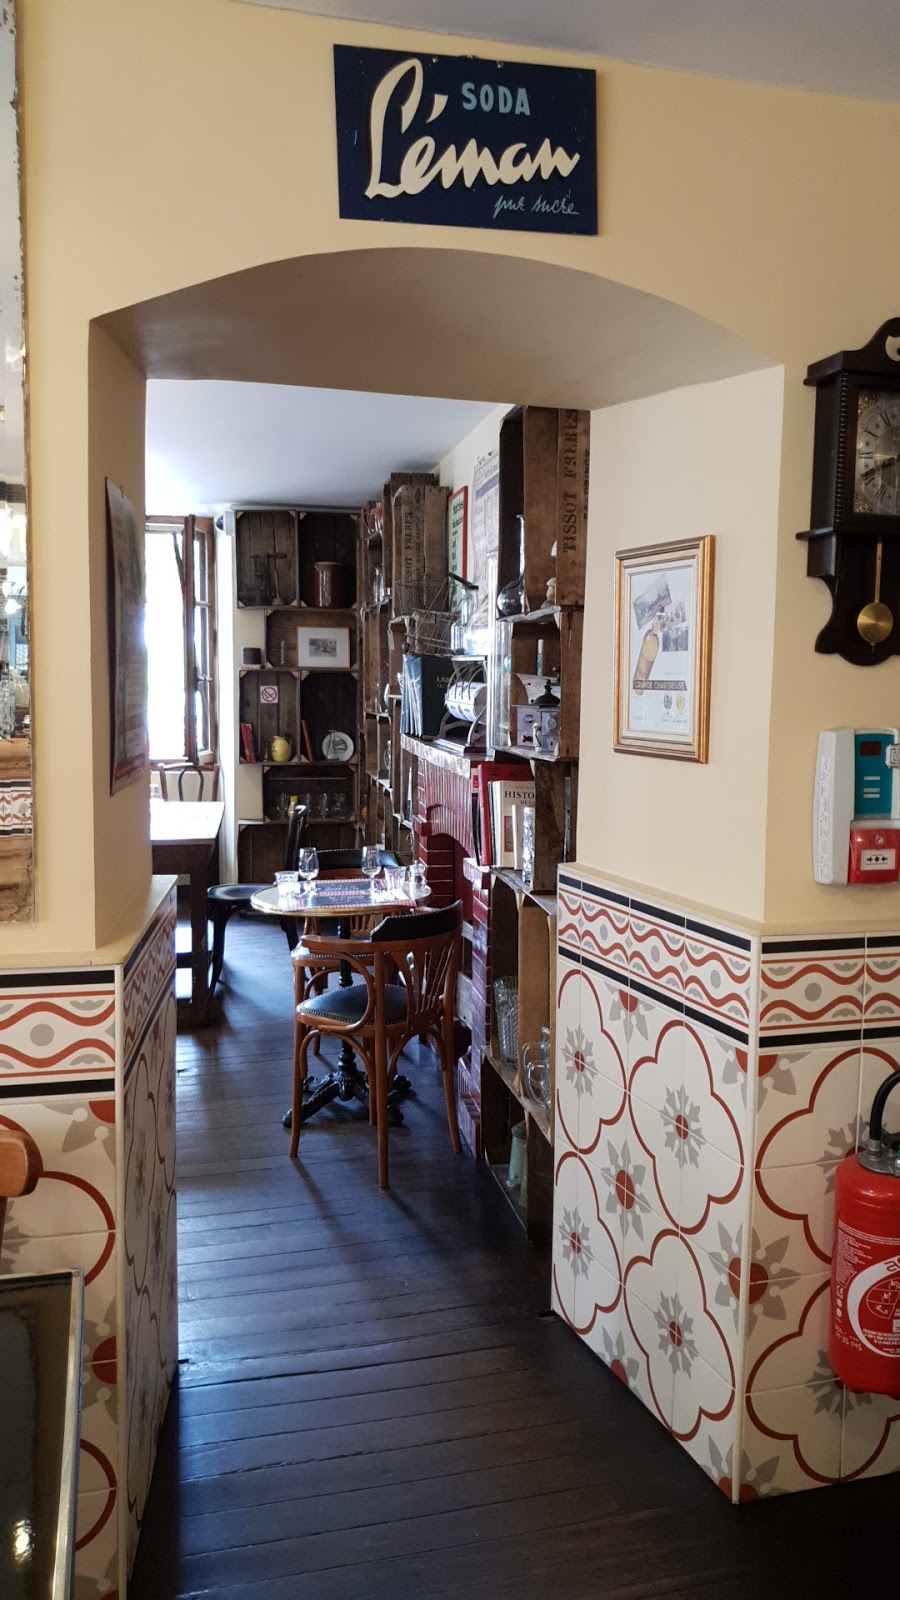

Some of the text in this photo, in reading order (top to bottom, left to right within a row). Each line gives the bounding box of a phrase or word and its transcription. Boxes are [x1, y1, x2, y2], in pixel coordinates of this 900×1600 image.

[461, 82, 531, 115] SODA
[493, 195, 526, 219] pur
[563, 491, 578, 554] TISSOT
[504, 791, 535, 800] HISTO
